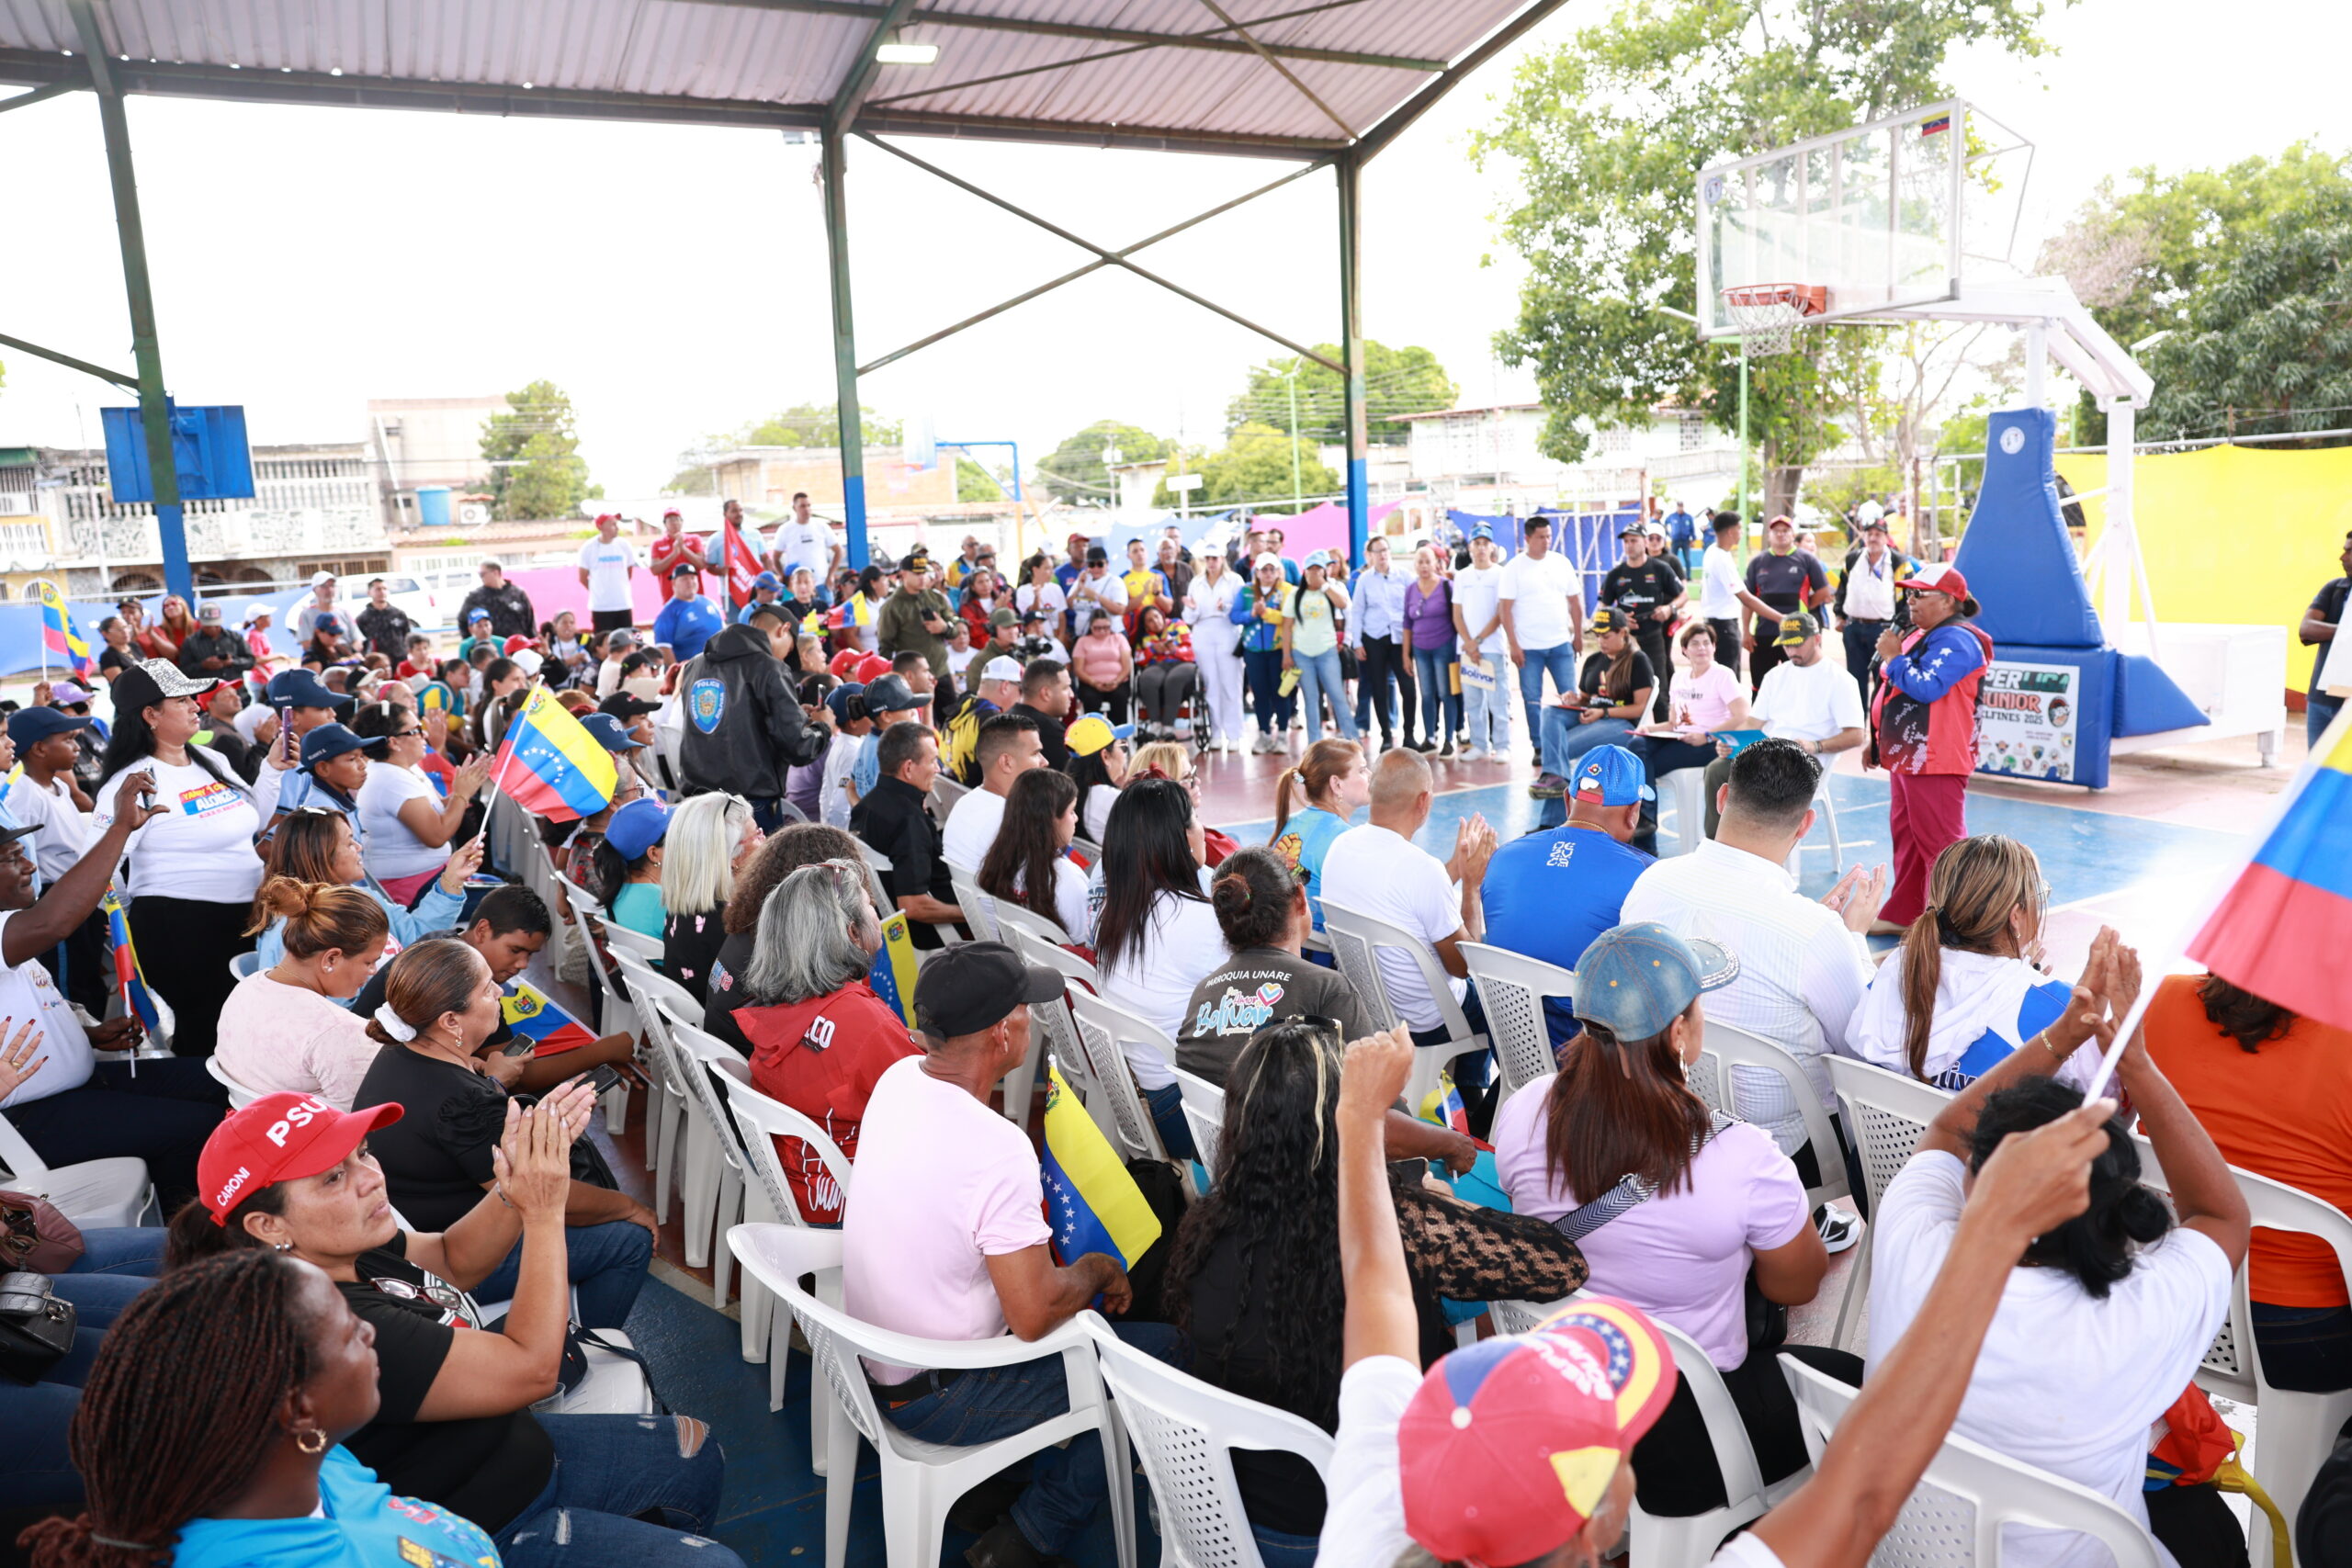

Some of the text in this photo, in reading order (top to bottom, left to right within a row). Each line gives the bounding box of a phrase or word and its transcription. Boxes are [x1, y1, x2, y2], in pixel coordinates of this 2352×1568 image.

[1205, 970, 1292, 988] PARROQUIA UNARE
[266, 1098, 328, 1148] PSU
